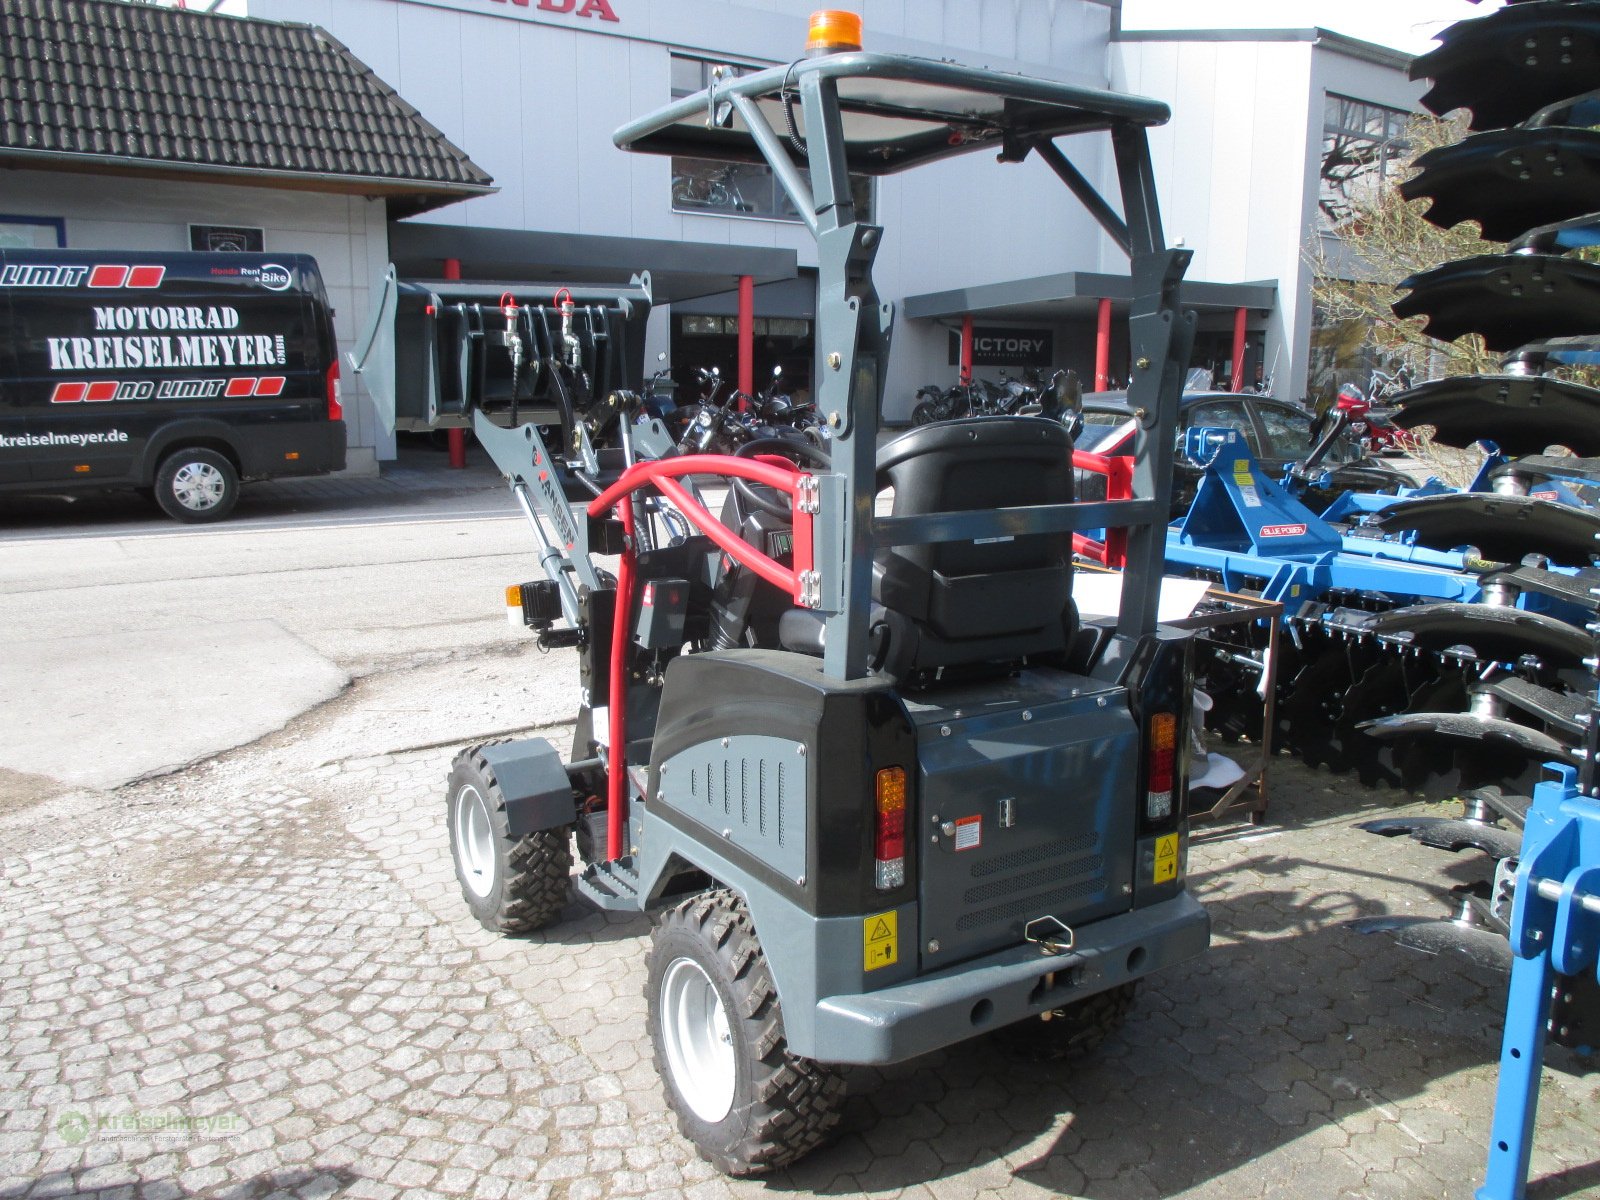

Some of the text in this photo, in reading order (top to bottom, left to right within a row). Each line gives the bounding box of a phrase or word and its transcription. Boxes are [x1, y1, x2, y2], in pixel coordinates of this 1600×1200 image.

[0, 265, 89, 287] LIMIT
[261, 272, 287, 283] Bike
[93, 306, 239, 331] MOTORRAD
[47, 334, 276, 370] KREISELMEYER
[972, 337, 1044, 353] ICTORY
[156, 379, 226, 399] LIMIT
[1263, 527, 1281, 535] BLUE
